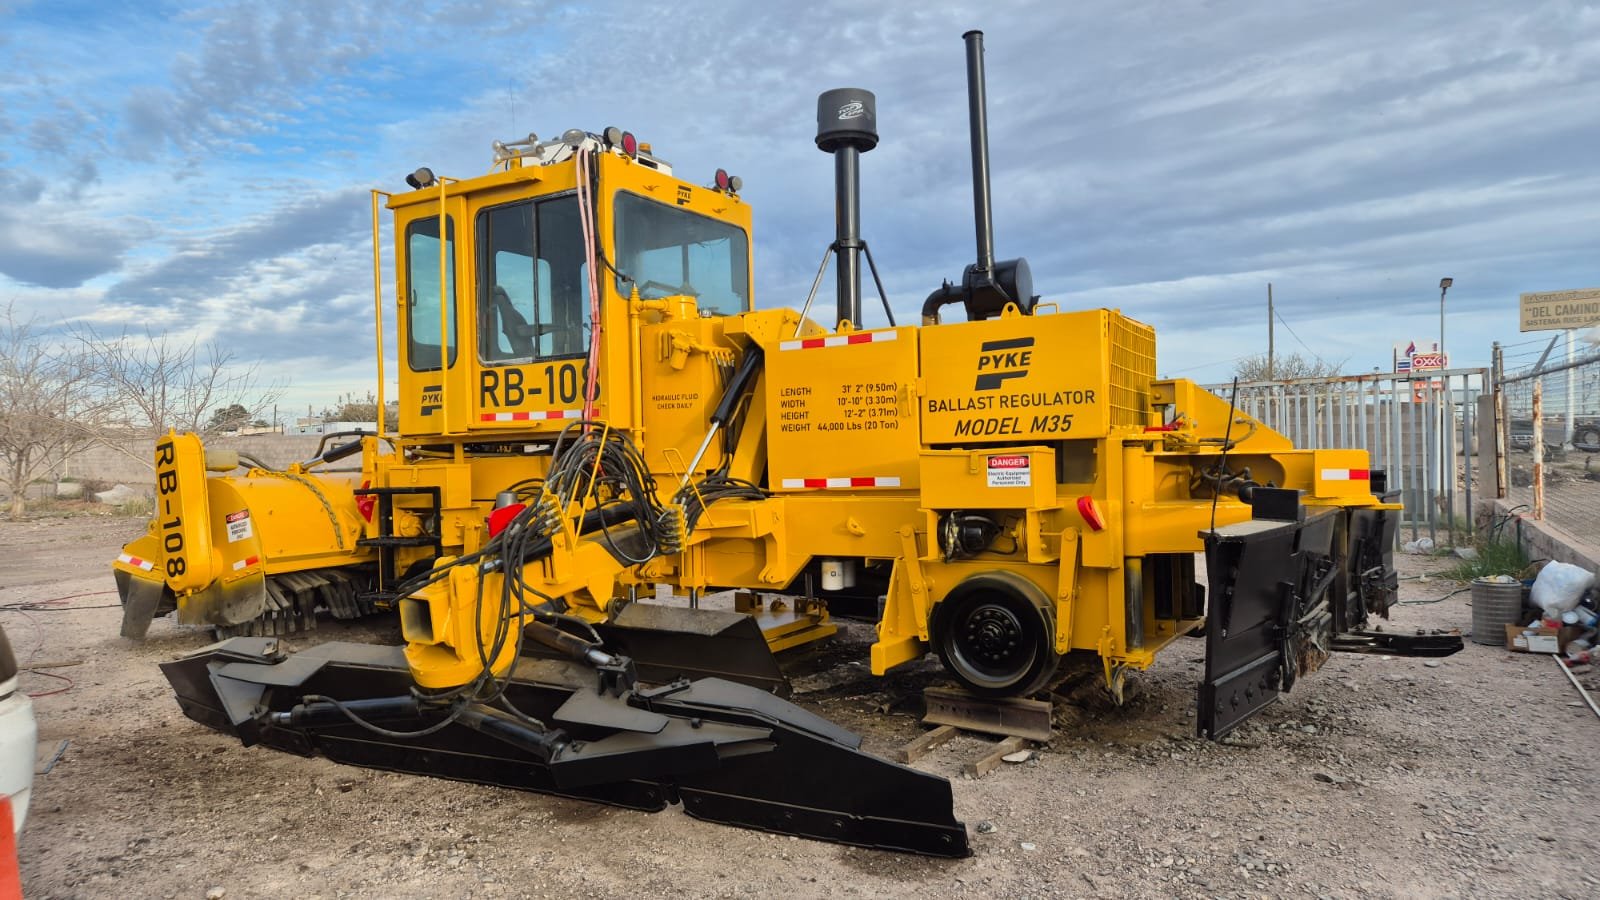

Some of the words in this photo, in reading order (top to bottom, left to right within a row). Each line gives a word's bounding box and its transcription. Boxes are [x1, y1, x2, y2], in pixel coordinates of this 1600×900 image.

[978, 350, 1032, 370] PYKE
[1414, 357, 1446, 366] OXXO
[480, 363, 601, 408] RB-108
[780, 387, 812, 397] LENGTH
[866, 382, 898, 393] (9.50m)
[421, 393, 442, 404] PYK
[780, 399, 805, 409] WIDTH
[865, 395, 898, 405] (3.30m)
[928, 396, 995, 413] BALLAST
[1000, 390, 1095, 409] REGULATOR
[781, 411, 809, 421] HEIGHT
[868, 407, 898, 418] (3.71m)
[781, 423, 811, 433] WEIGHT
[817, 422, 845, 432] 44,000
[846, 421, 862, 431] Lbs
[864, 421, 877, 431] (20
[880, 420, 899, 430] Ton)
[954, 417, 1022, 437] MODEL
[1030, 414, 1073, 433] M35
[156, 441, 186, 578] RB-108
